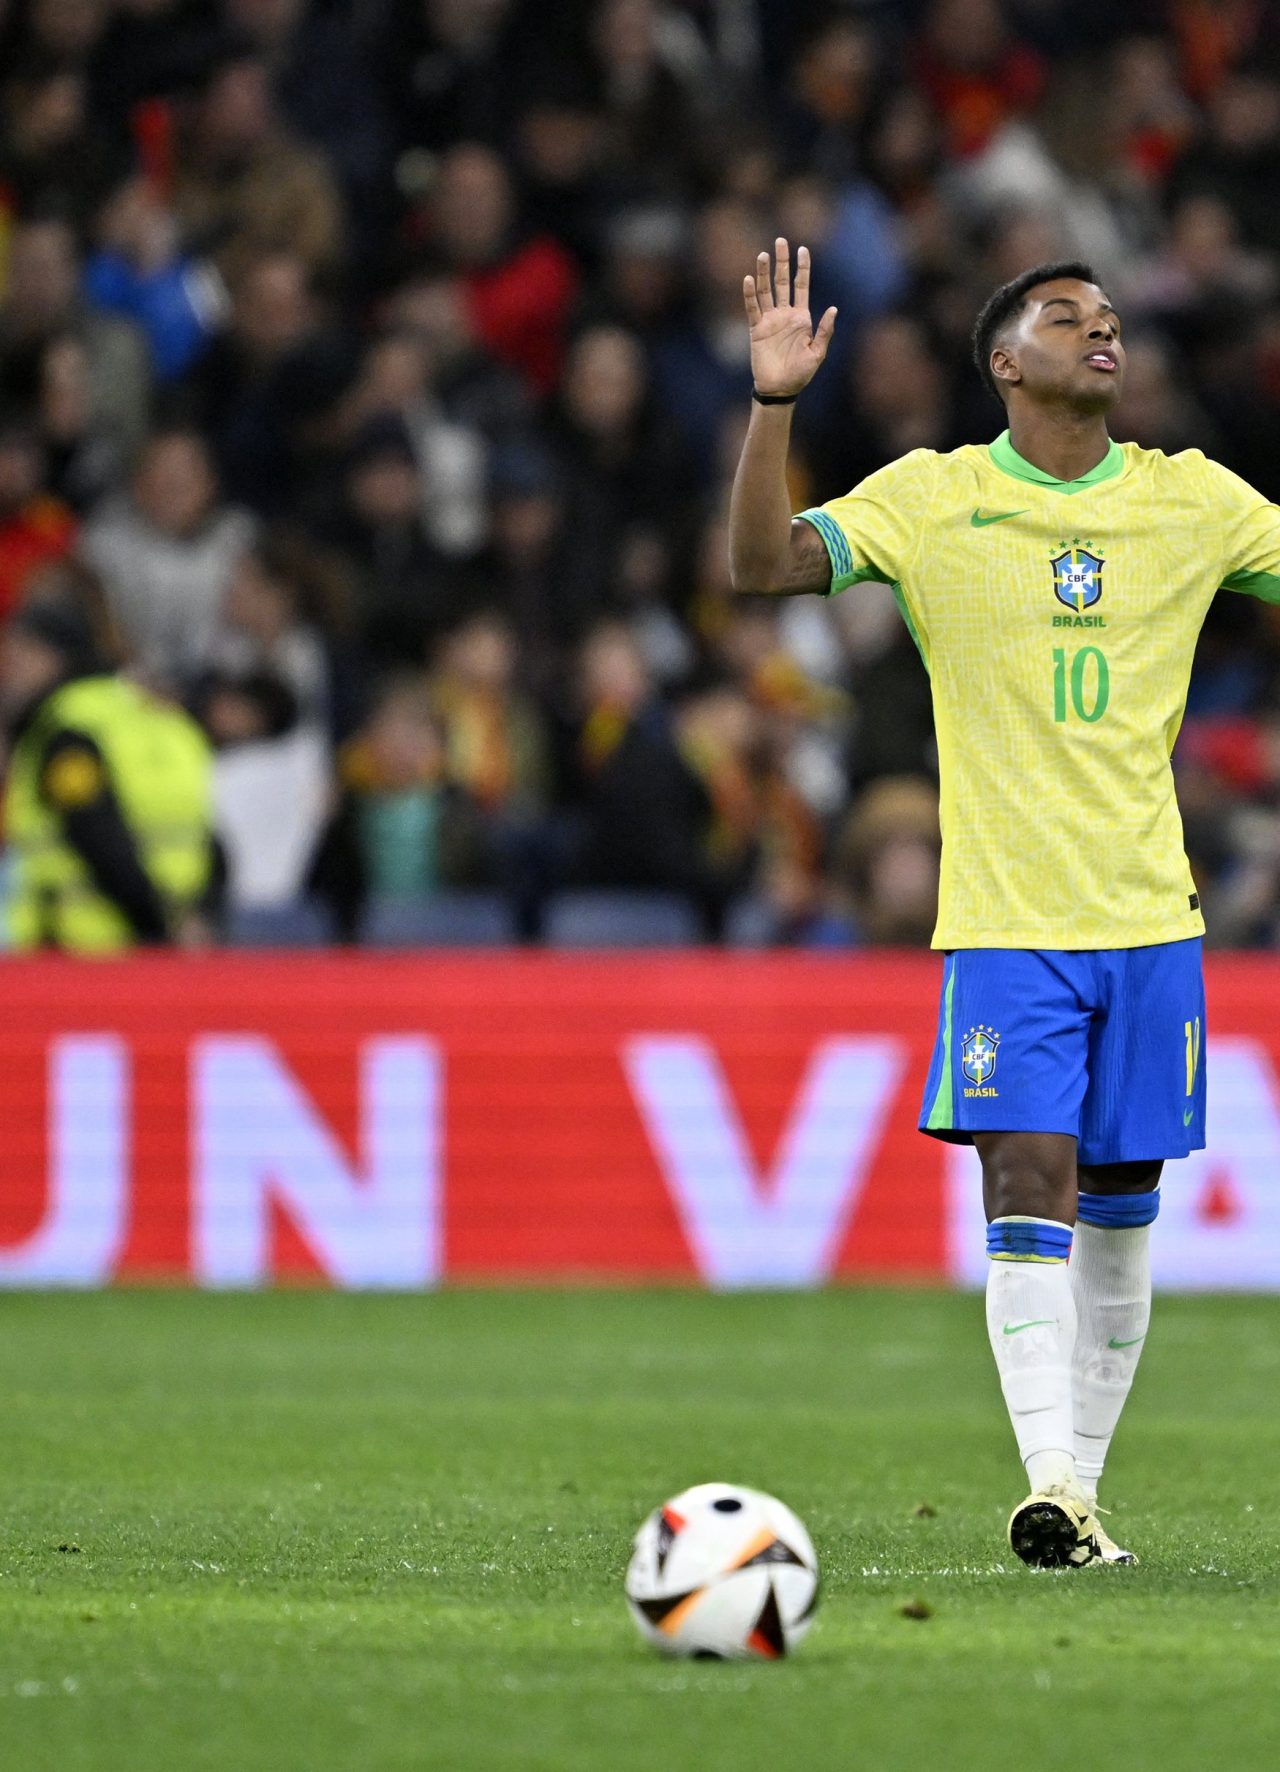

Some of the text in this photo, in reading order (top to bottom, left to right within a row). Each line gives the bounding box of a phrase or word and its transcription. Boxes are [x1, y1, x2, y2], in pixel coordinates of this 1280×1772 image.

[1067, 574, 1087, 583] CBF
[1052, 616, 1107, 628] BRASIL
[1053, 647, 1109, 722] 10
[971, 1052, 985, 1061] CBF
[964, 1087, 999, 1097] BRASIL
